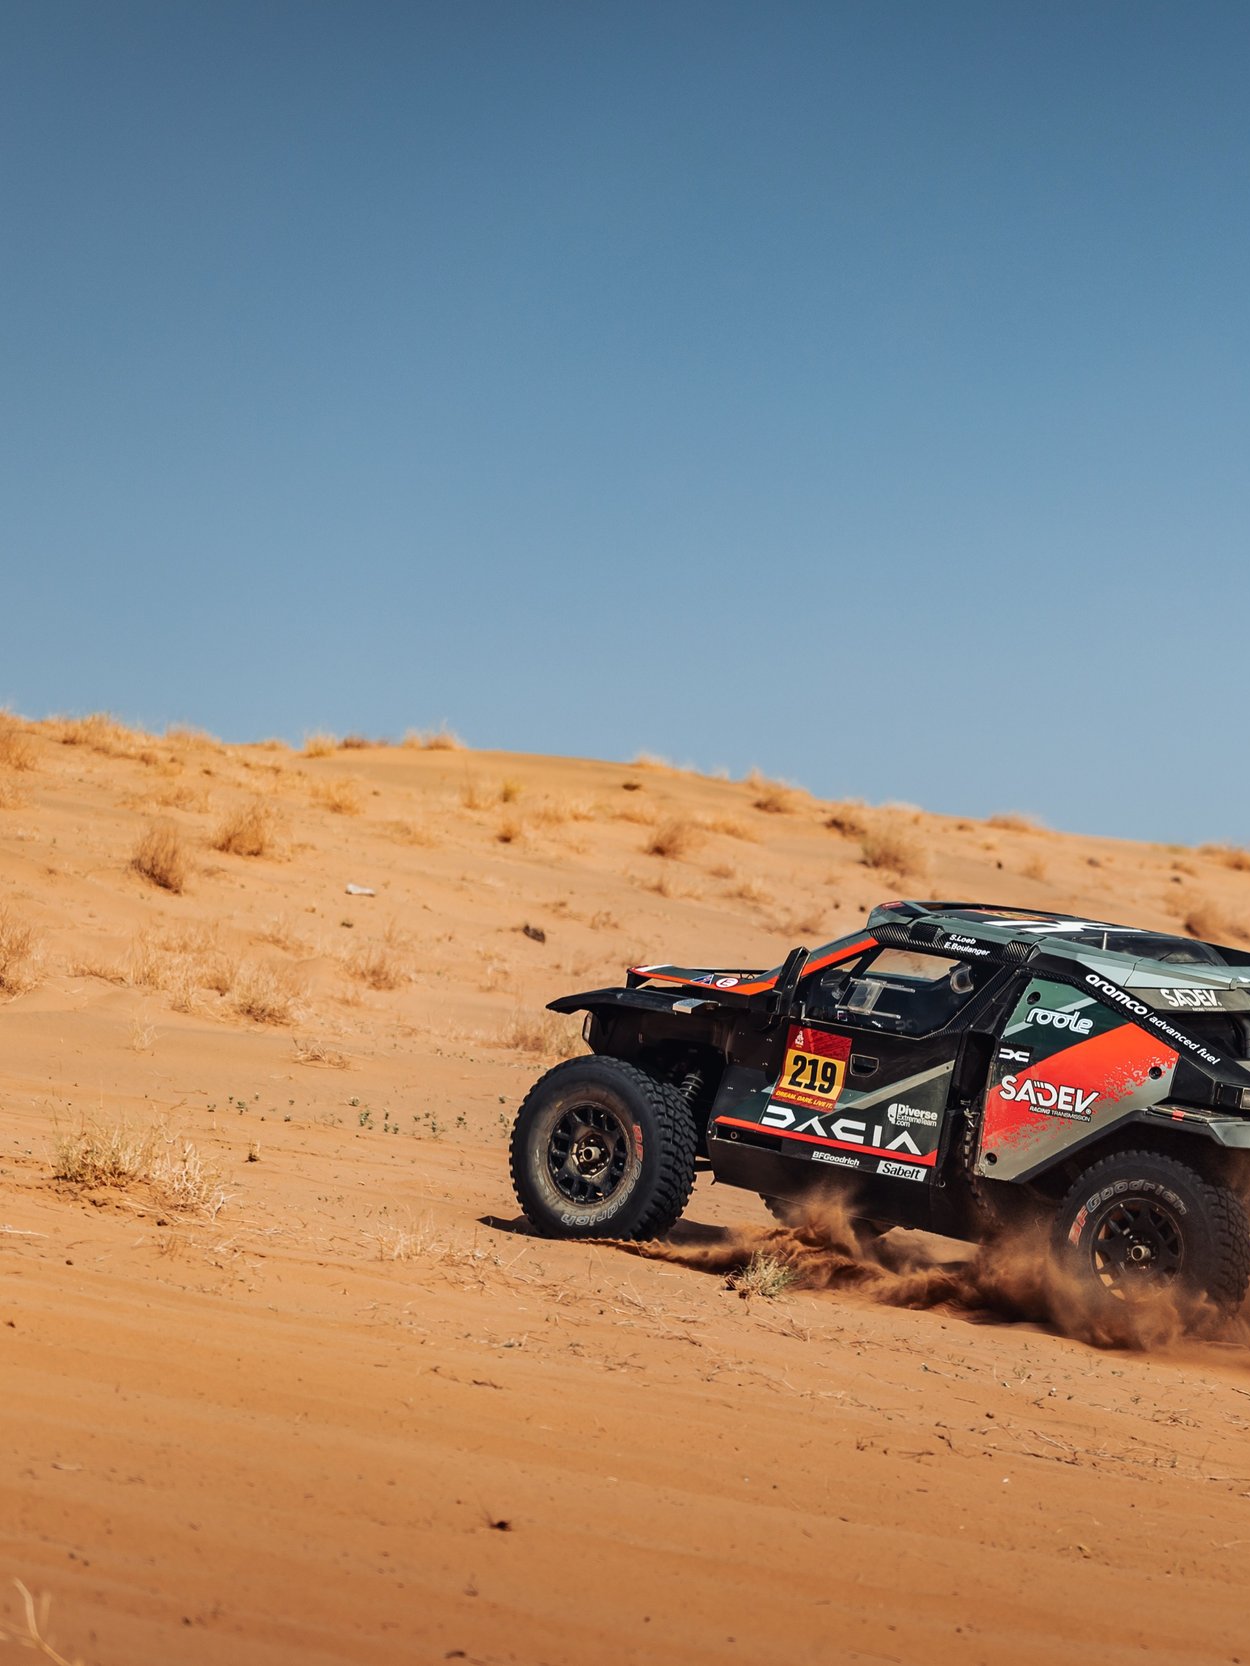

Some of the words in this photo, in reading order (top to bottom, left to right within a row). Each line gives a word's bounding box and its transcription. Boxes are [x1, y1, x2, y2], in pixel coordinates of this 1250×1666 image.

[949, 934, 977, 945] S.Loeb
[944, 942, 990, 956] E.Boulanger
[1086, 973, 1148, 1016] aramco
[1161, 989, 1218, 1007] SADEV
[1149, 1014, 1199, 1051] advanced
[1197, 1047, 1221, 1065] fuel
[788, 1055, 837, 1094] 219
[999, 1075, 1099, 1113] SADEV
[898, 1103, 938, 1120] Diverse
[1029, 1105, 1051, 1115] RACING
[1051, 1109, 1091, 1122] TRANSMISSION
[761, 1105, 921, 1155] DACIA
[895, 1119, 911, 1127] .com
[812, 1151, 860, 1166] BFGoodrich
[882, 1162, 921, 1180] Sabelt
